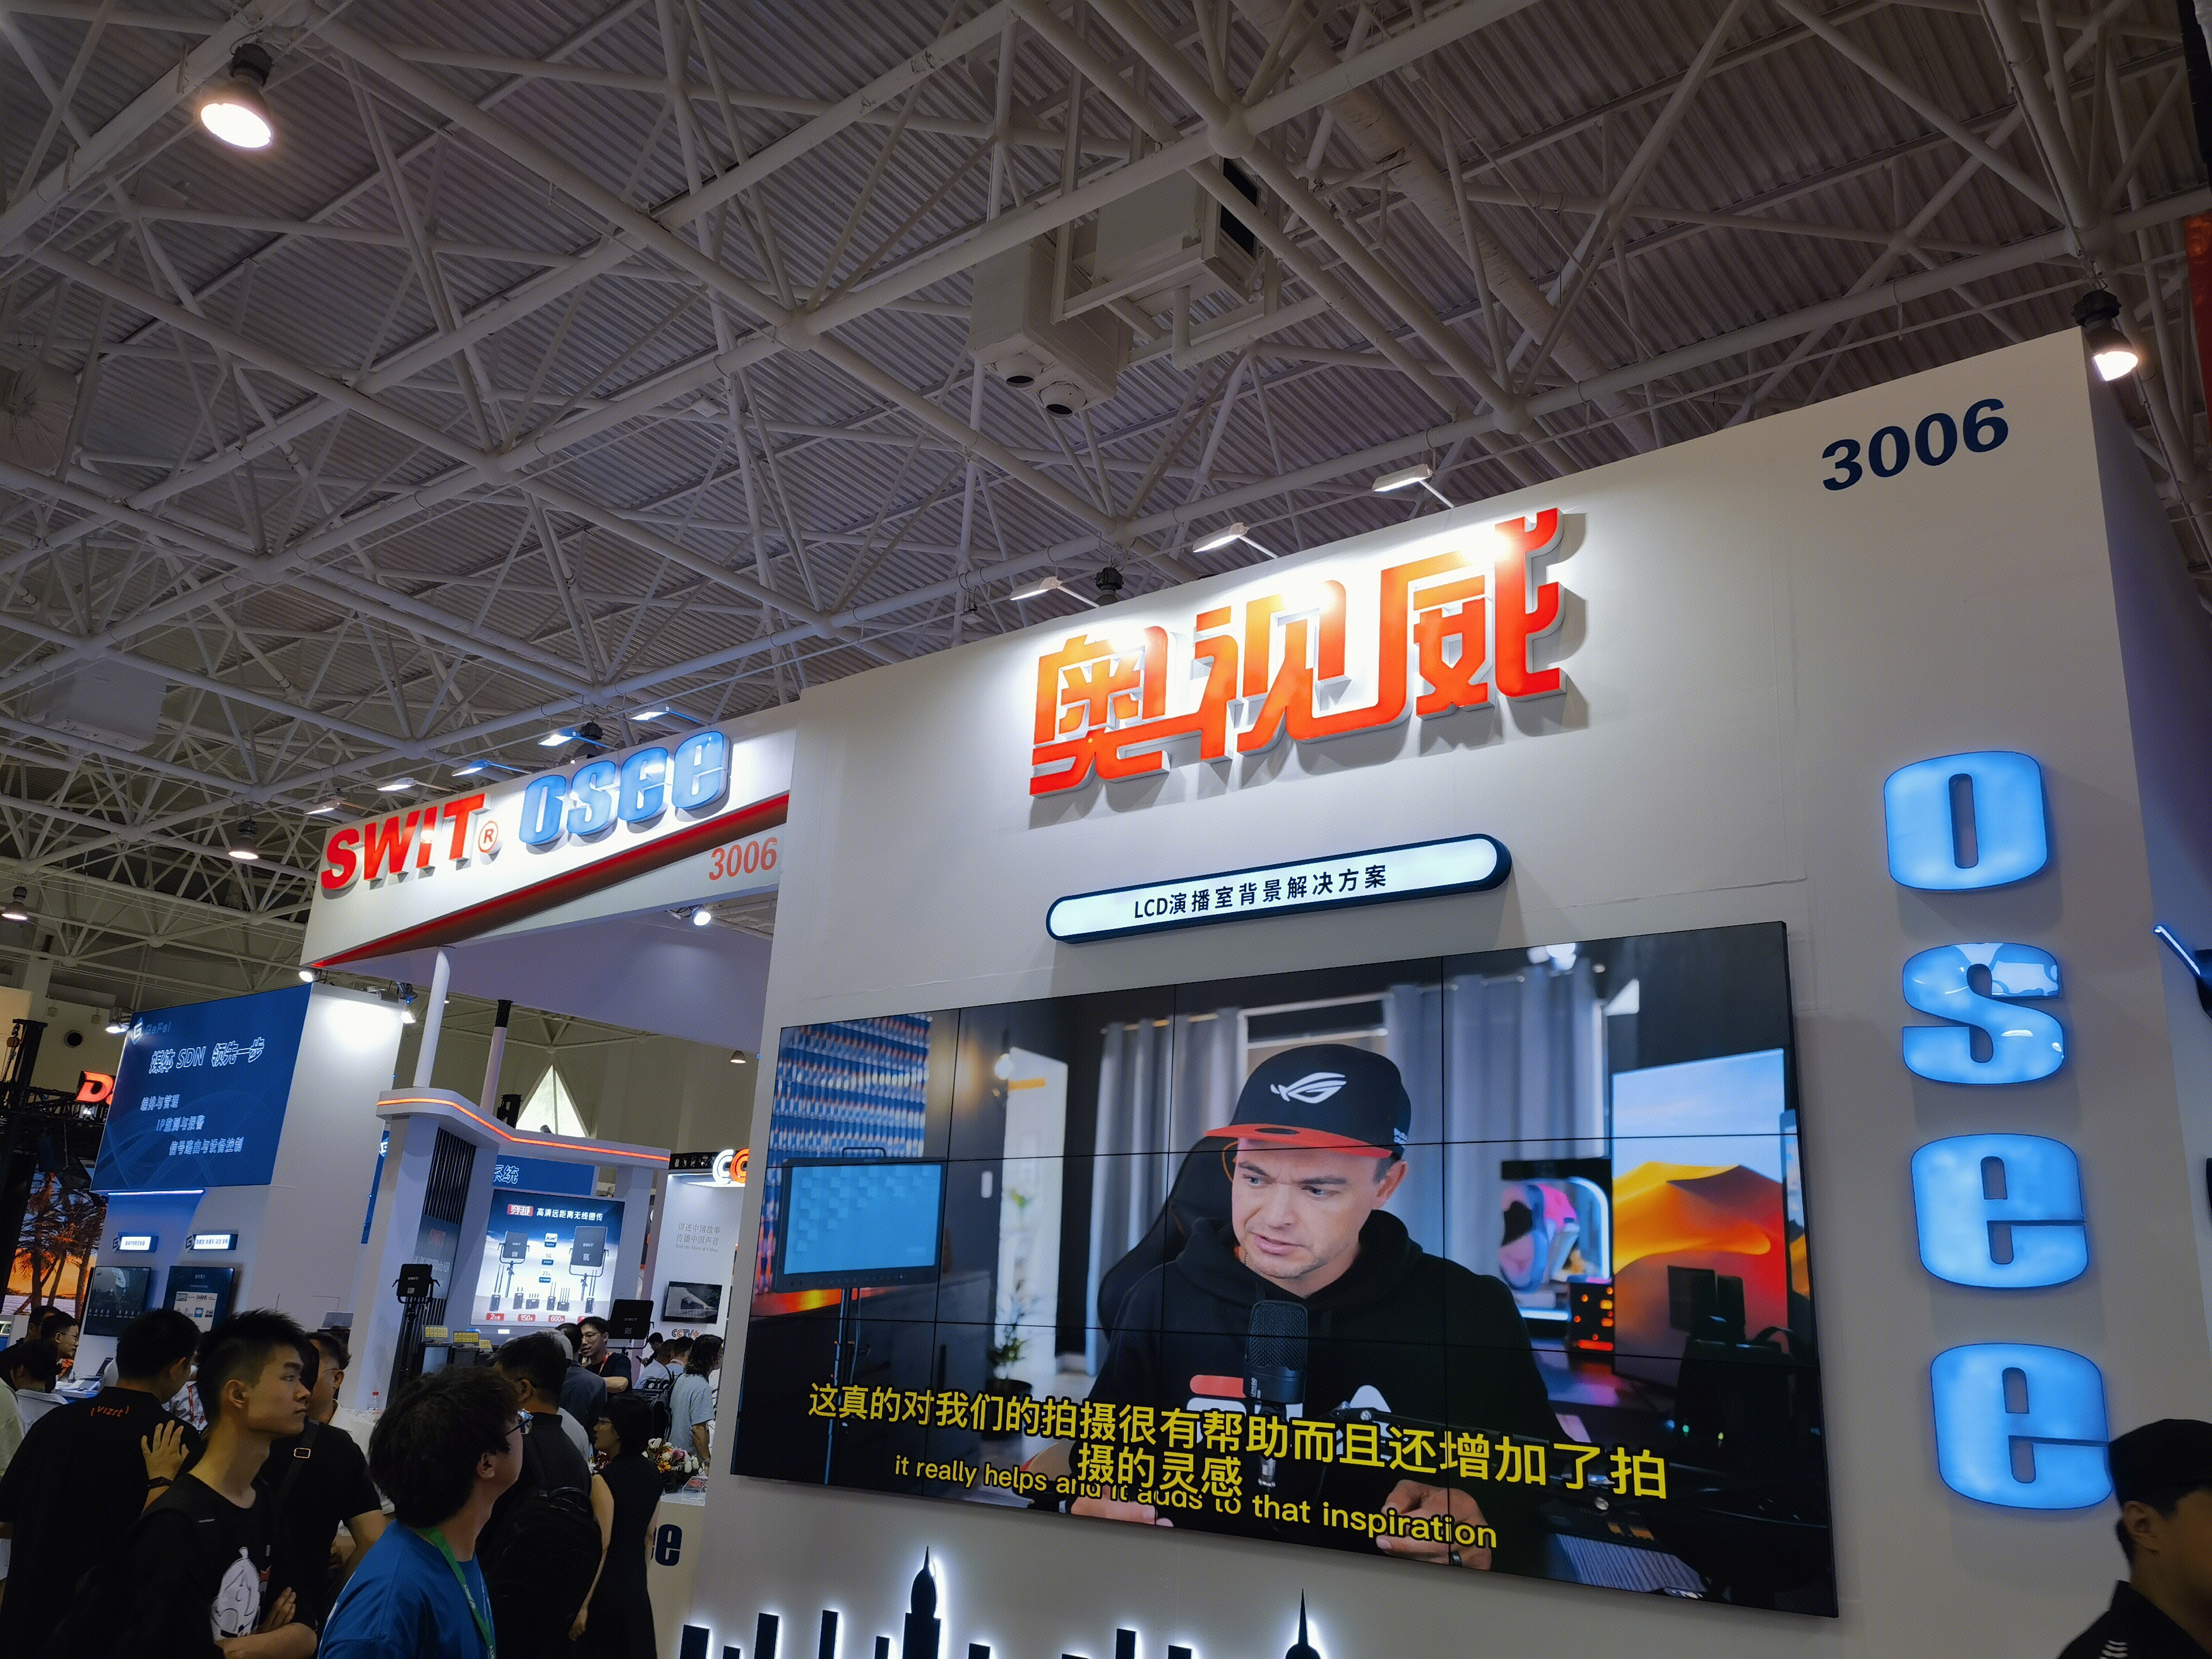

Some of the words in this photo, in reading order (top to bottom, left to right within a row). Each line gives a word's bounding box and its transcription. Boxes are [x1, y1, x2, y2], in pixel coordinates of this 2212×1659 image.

[1822, 399, 2008, 490] 3006
[1030, 507, 1564, 797] 奥视威
[321, 793, 489, 890] SWIT
[520, 731, 727, 845] osee
[709, 837, 778, 881] 3006
[1135, 865, 1386, 919] LCD演播室背景解决方案
[149, 1049, 176, 1074] 媒体
[176, 1047, 206, 1069] SDN
[211, 1037, 265, 1068] 领先一步
[76, 1071, 113, 1105] D
[169, 1136, 244, 1156] 信号路由与设备控制
[510, 1205, 532, 1217] 穿越
[536, 1208, 604, 1222] 高清远距离无线图传
[678, 1222, 721, 1235] 讲述中国故事
[677, 1233, 719, 1246] 传播中国声音
[808, 1382, 1667, 1500] 这真的对我们的拍摄很有帮助而且还增加了拍
[1077, 1442, 1243, 1498] 摄的灵感
[895, 1454, 909, 1475] it
[916, 1460, 977, 1488] really
[985, 1463, 1047, 1494] helps
[1252, 1494, 1311, 1523] that
[1323, 1501, 1498, 1548] inspiration
[650, 1524, 683, 1566] e
